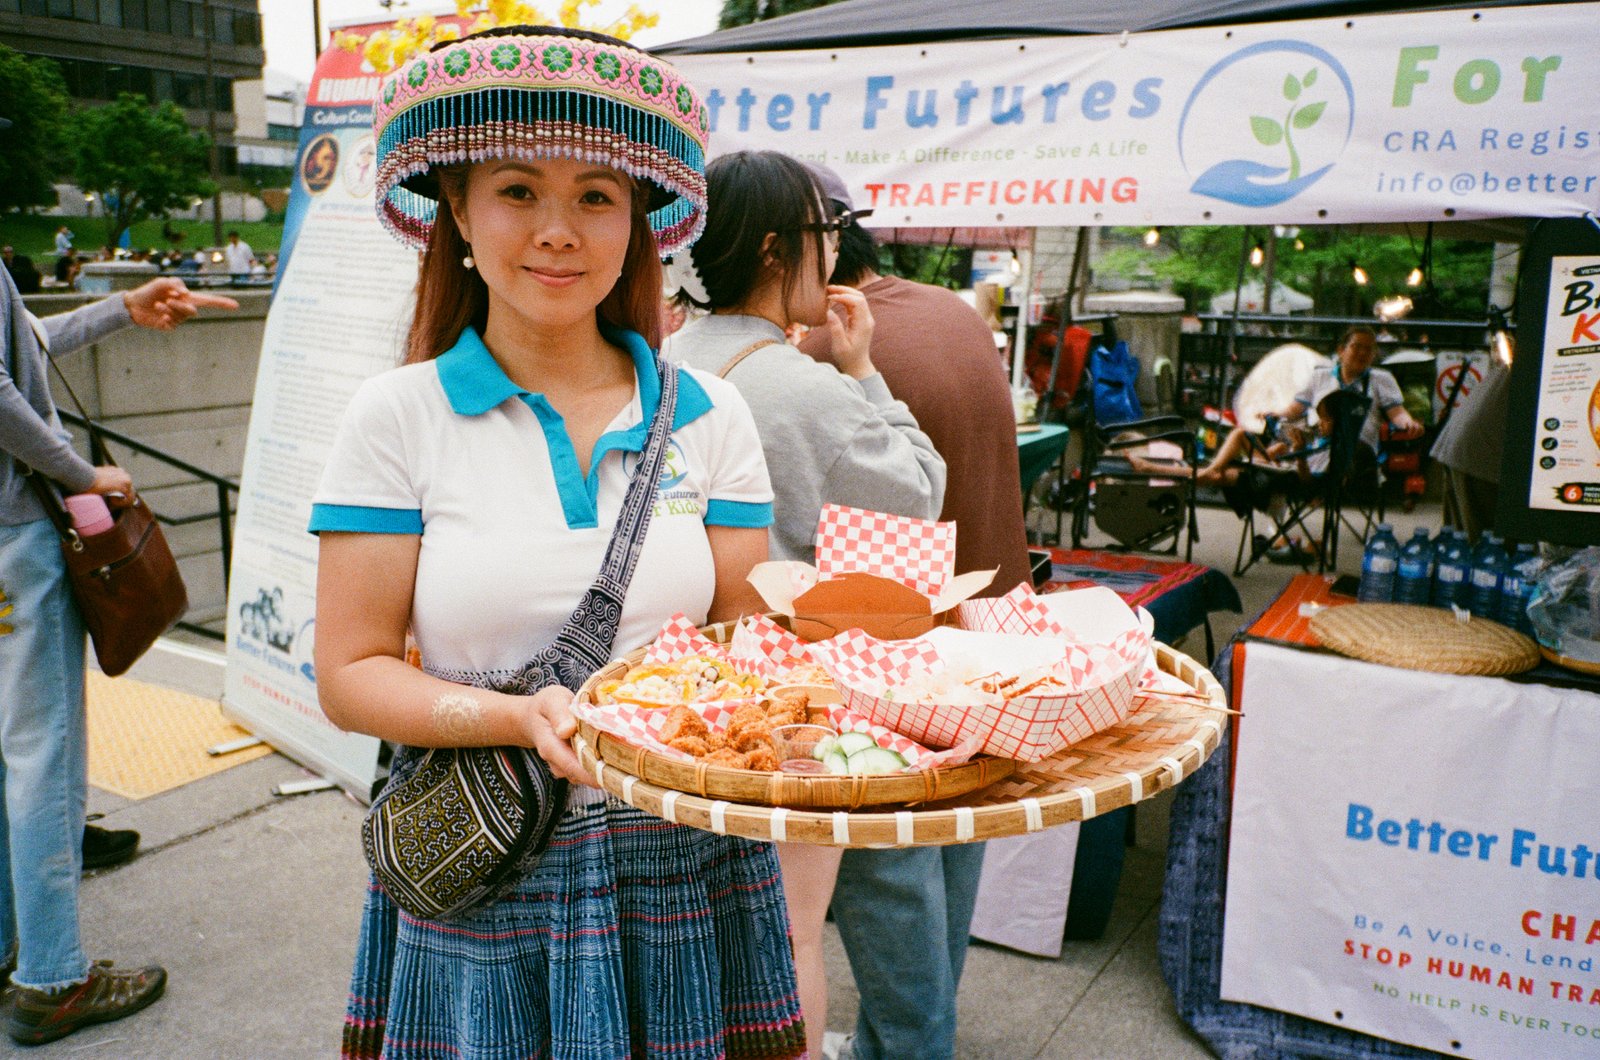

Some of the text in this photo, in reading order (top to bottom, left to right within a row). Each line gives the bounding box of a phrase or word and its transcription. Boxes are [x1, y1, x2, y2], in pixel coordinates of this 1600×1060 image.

[1392, 44, 1563, 108] For
[862, 75, 1165, 130] Futures
[845, 149, 892, 165] Make
[897, 149, 908, 163] A
[914, 146, 1015, 163] Difference
[1034, 144, 1082, 160] Save
[1088, 142, 1101, 157] A
[1107, 138, 1149, 158] Life
[1383, 125, 1600, 156] CRA Regis
[864, 175, 1140, 208] TRAFFICKING
[1376, 171, 1598, 196] info@better
[663, 489, 700, 500] Futures
[666, 499, 700, 516] Kids
[1345, 802, 1600, 882] Better Fut
[1353, 914, 1384, 931] Be
[1397, 923, 1413, 939] A
[1524, 948, 1593, 973] Lend
[1344, 938, 1412, 969] STOP
[1426, 956, 1535, 996] HUMAN
[1372, 981, 1400, 999] NO
[1408, 991, 1462, 1011] HELP
[1470, 1002, 1490, 1018] IS
[1498, 1008, 1550, 1032] EVER
